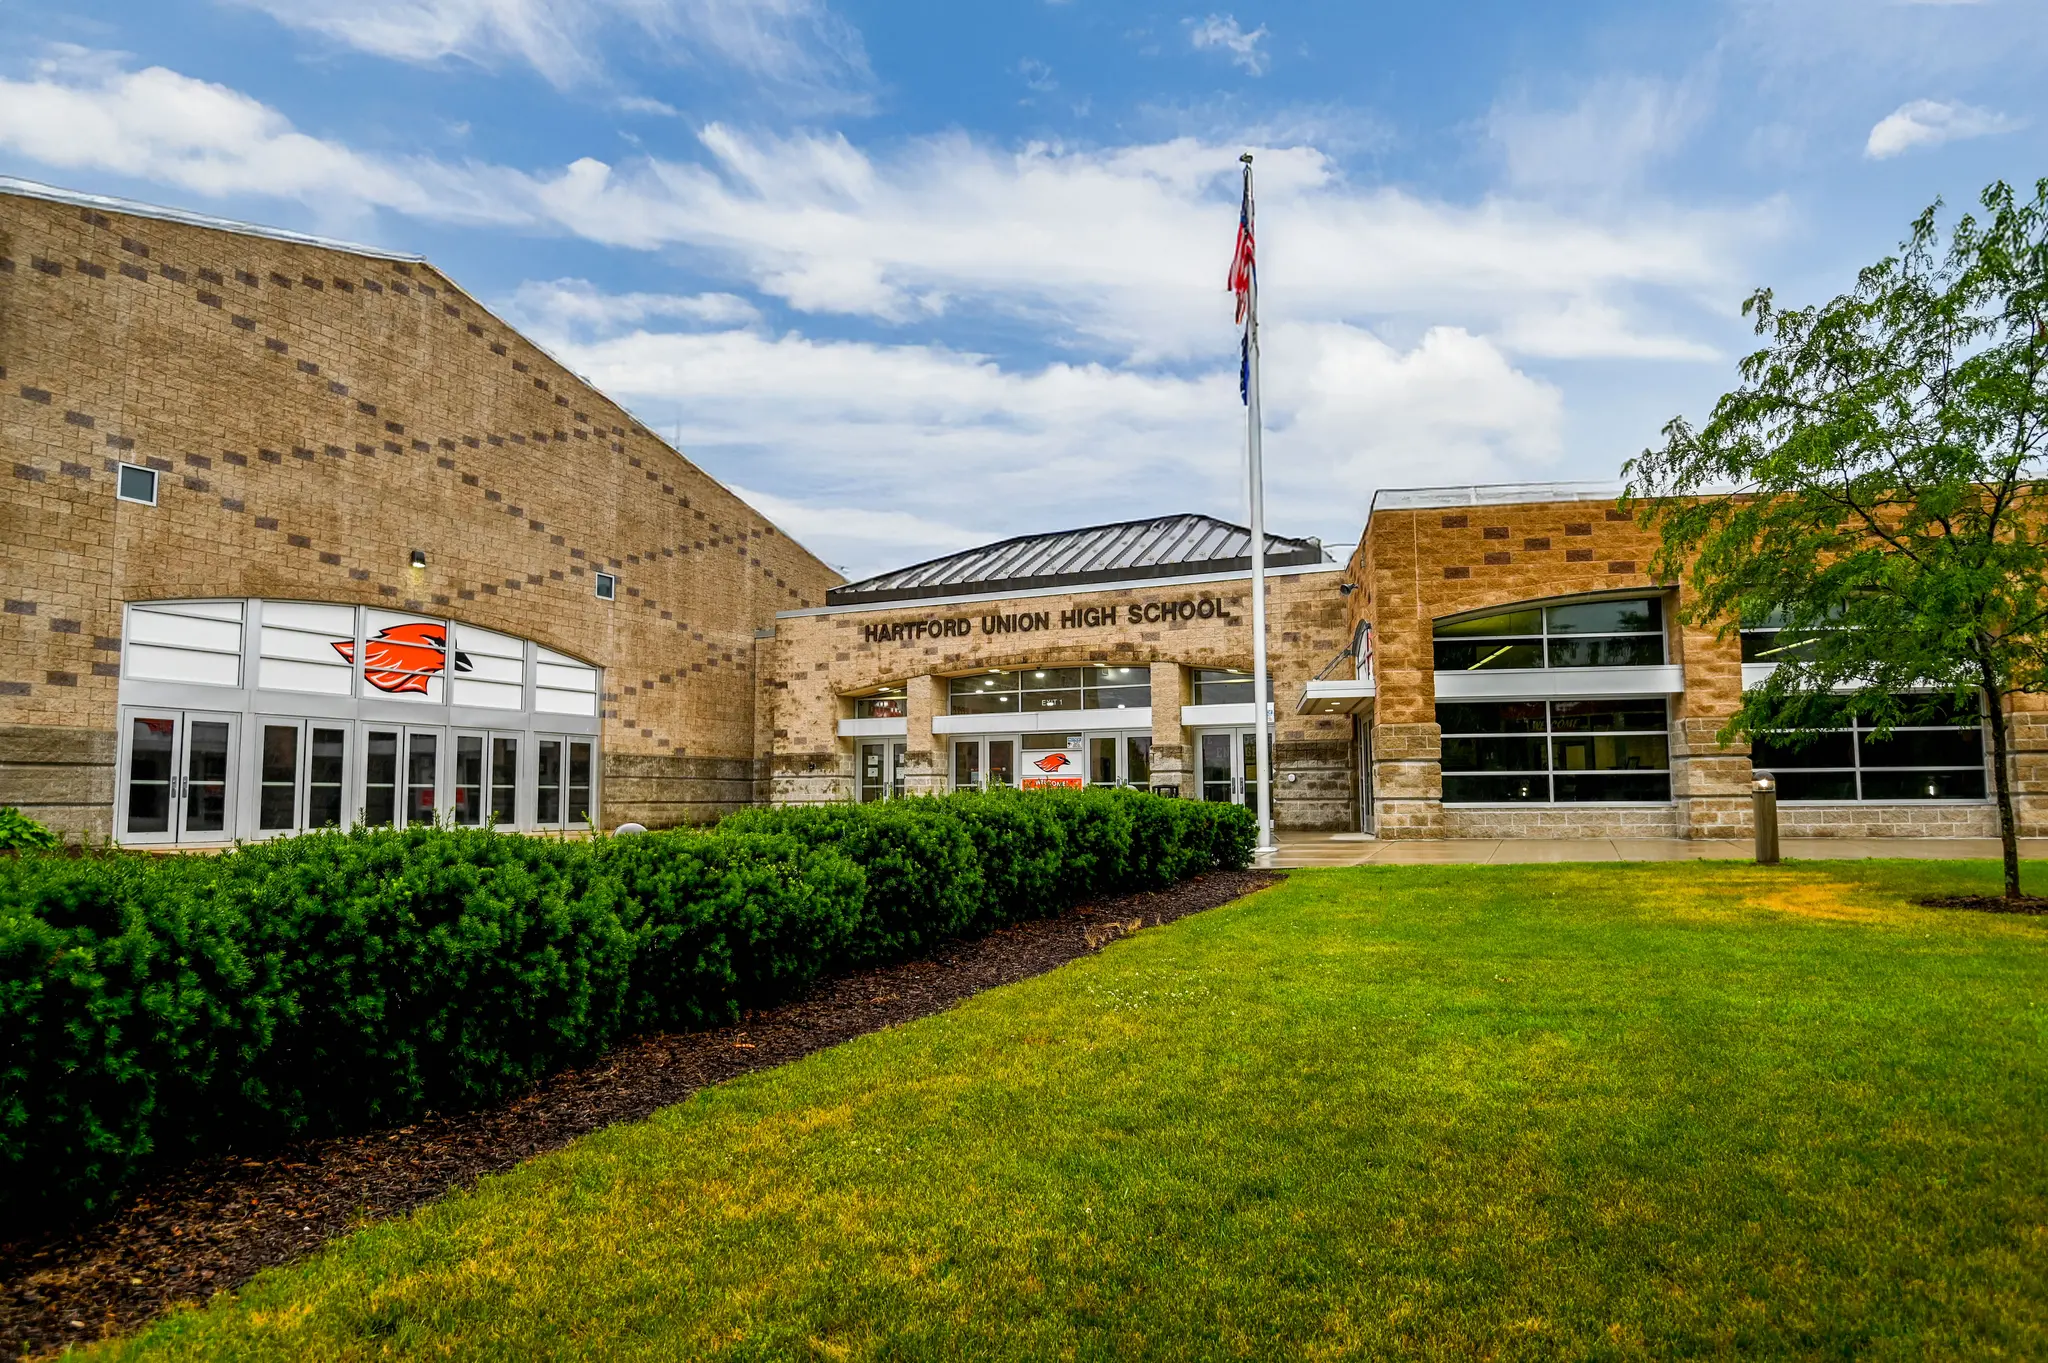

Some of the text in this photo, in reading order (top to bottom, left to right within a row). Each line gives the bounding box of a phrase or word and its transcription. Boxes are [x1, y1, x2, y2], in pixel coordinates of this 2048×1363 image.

[864, 598, 1231, 643] HARTFORD UNION HIGH SCHOOL
